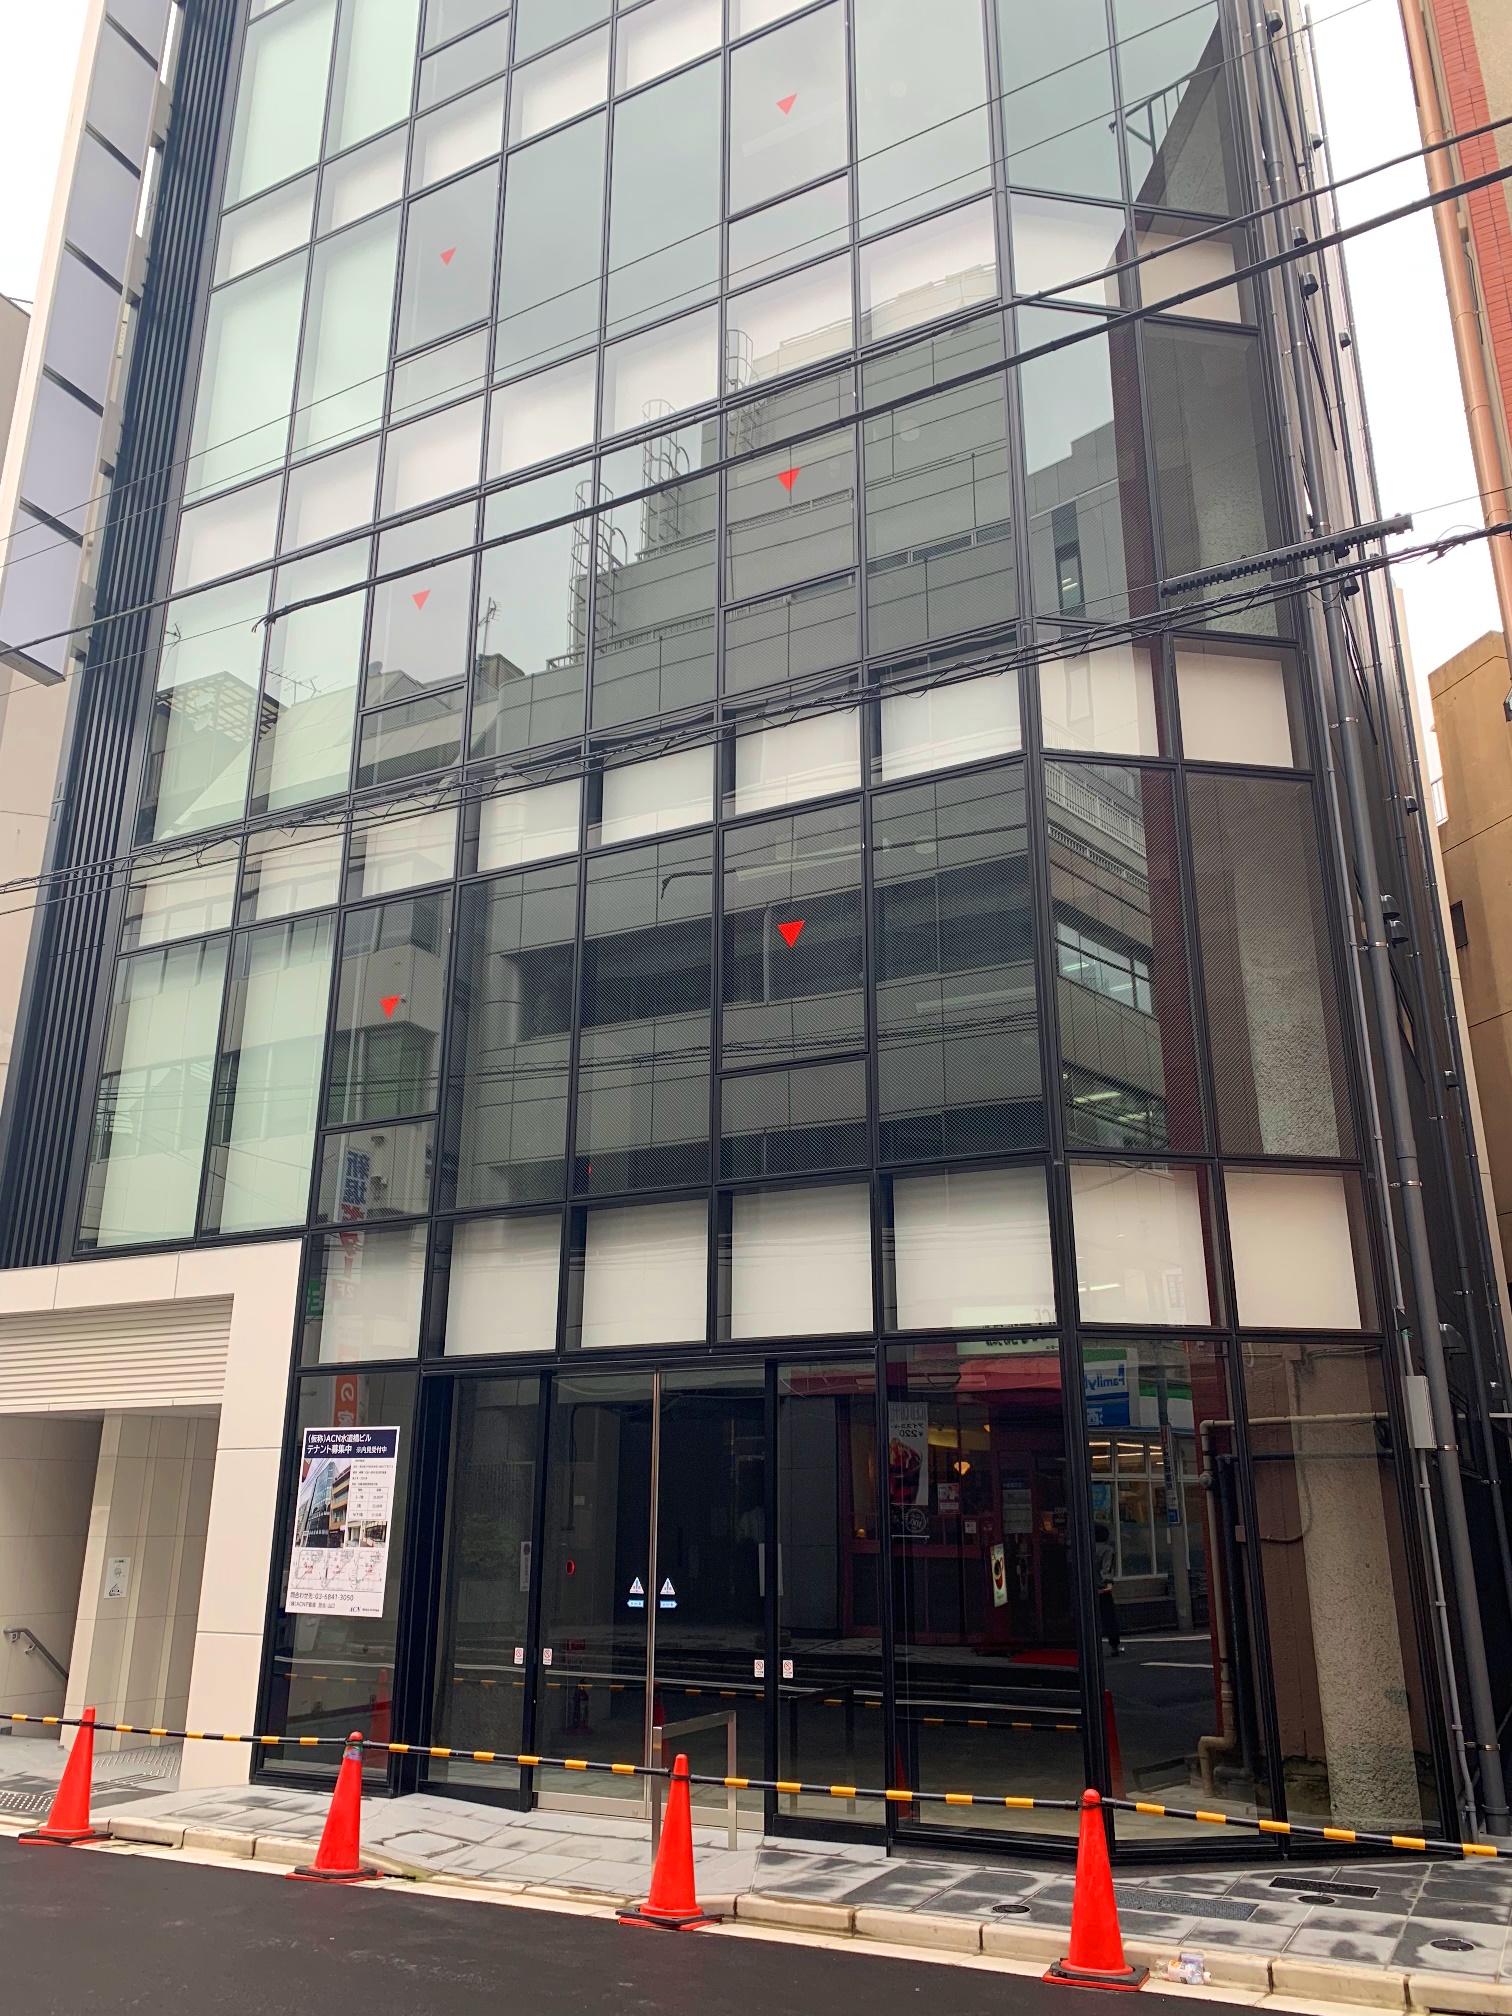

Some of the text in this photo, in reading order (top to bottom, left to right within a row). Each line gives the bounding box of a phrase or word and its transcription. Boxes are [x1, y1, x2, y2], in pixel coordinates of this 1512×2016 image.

[306, 1444, 353, 1454] テナント募集中
